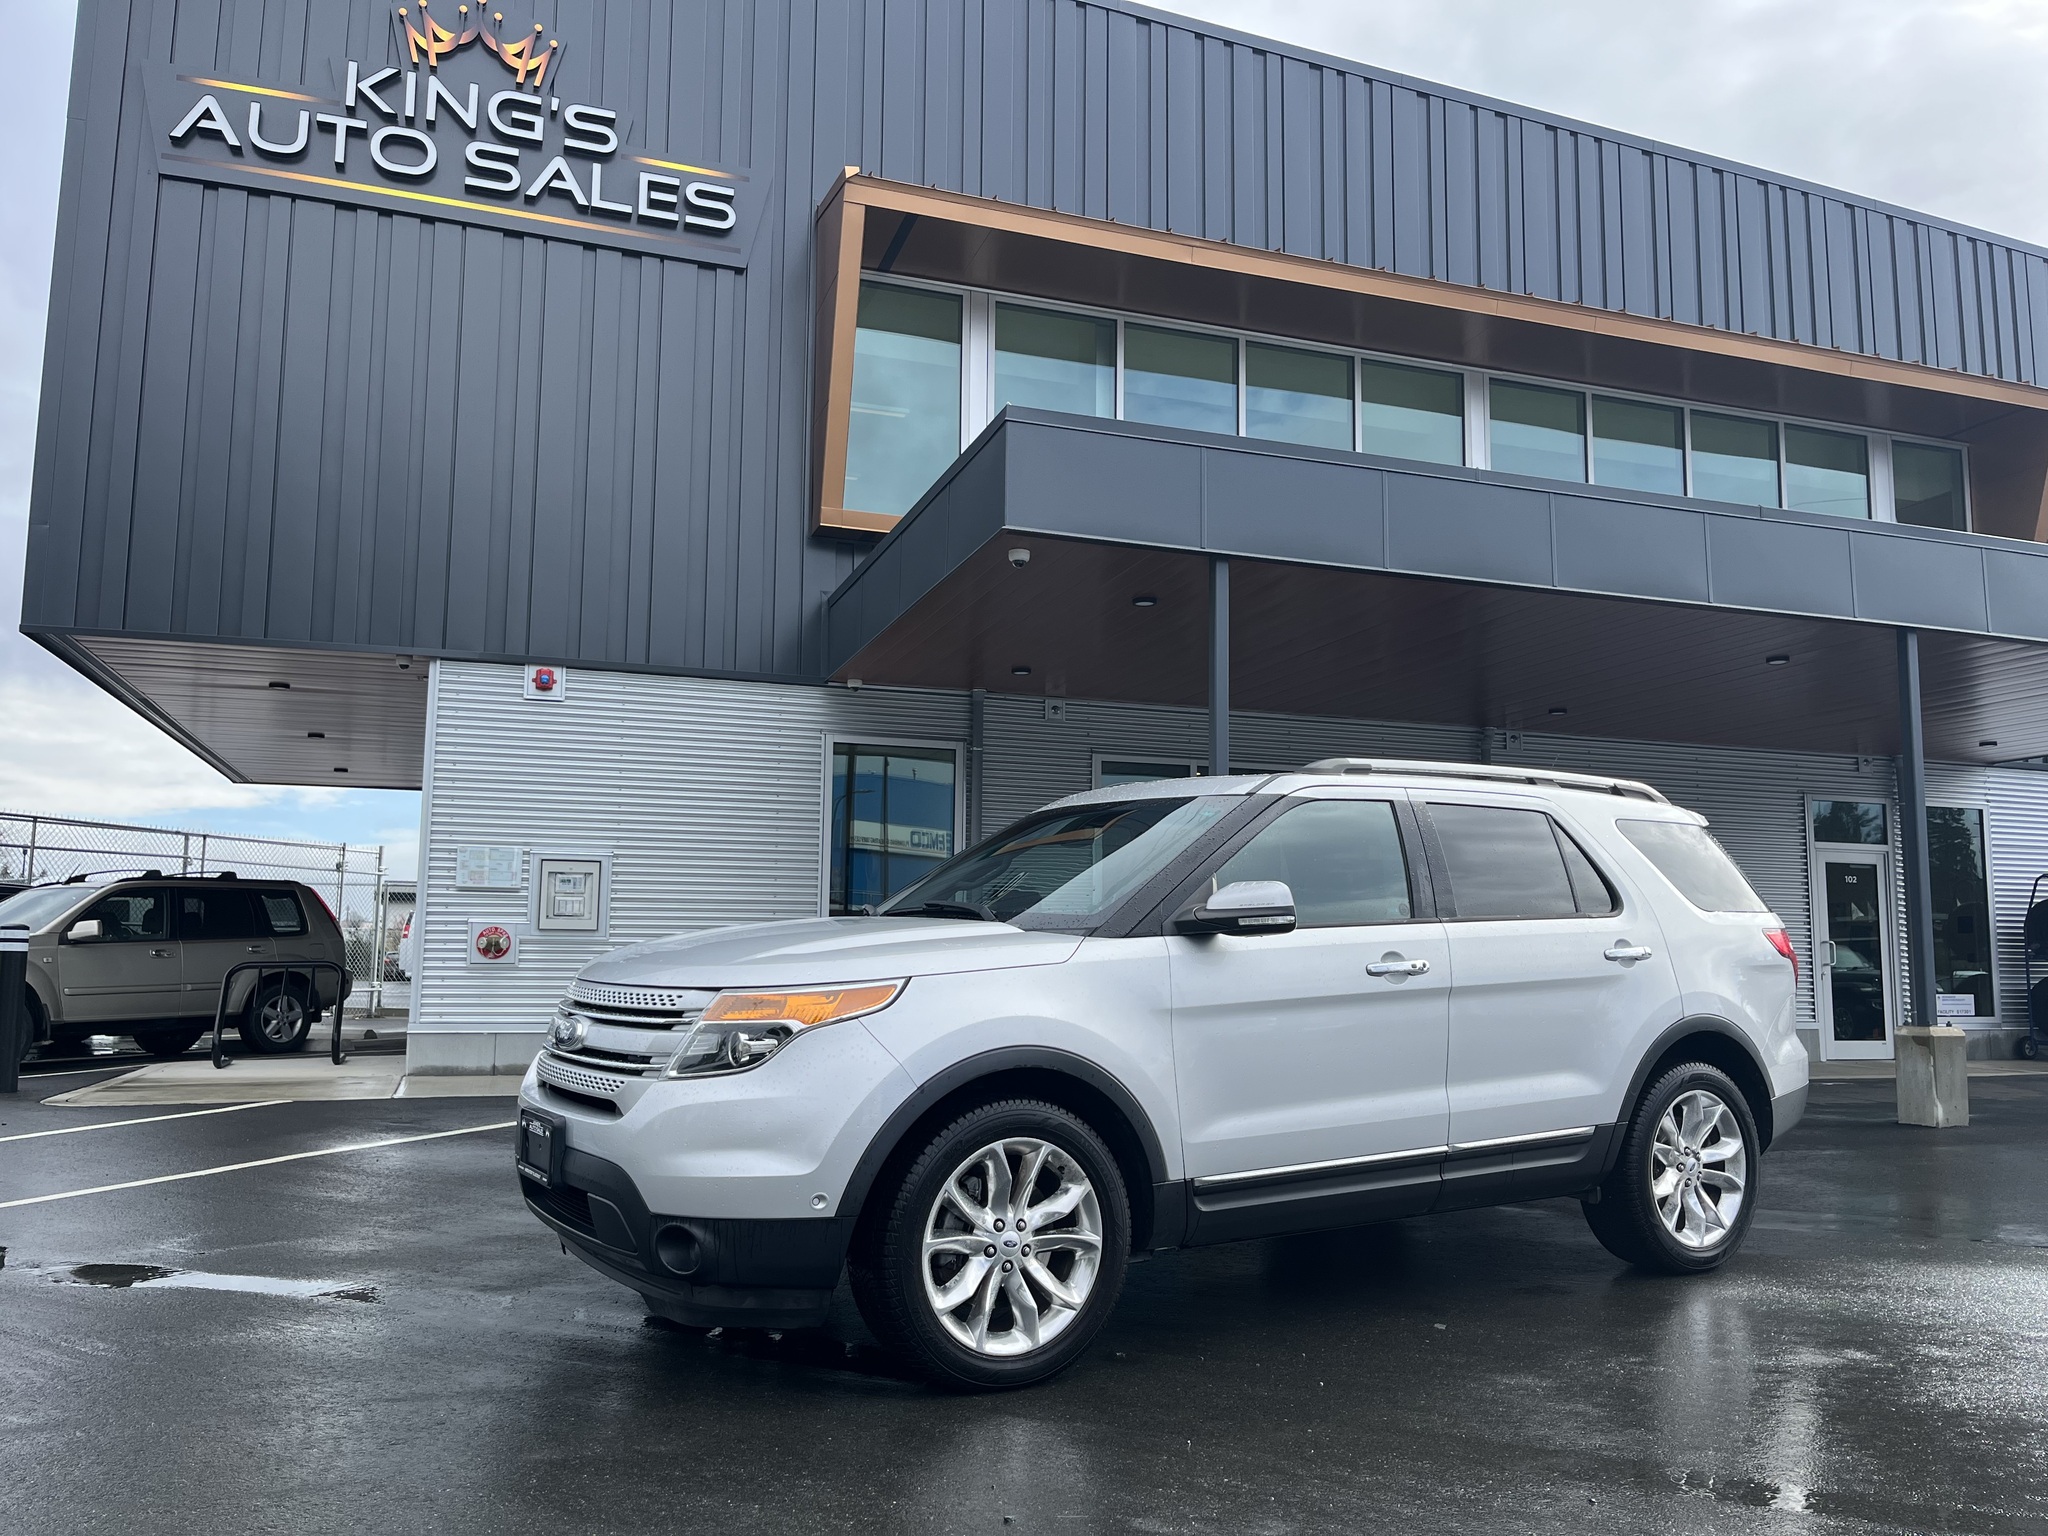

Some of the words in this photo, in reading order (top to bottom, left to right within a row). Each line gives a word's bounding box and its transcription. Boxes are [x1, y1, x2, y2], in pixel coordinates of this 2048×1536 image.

[345, 60, 619, 154] KING'S
[168, 94, 438, 176] AUTO
[464, 140, 737, 230] SALES
[1844, 875, 1858, 883] 102
[482, 927, 496, 936] AUTO
